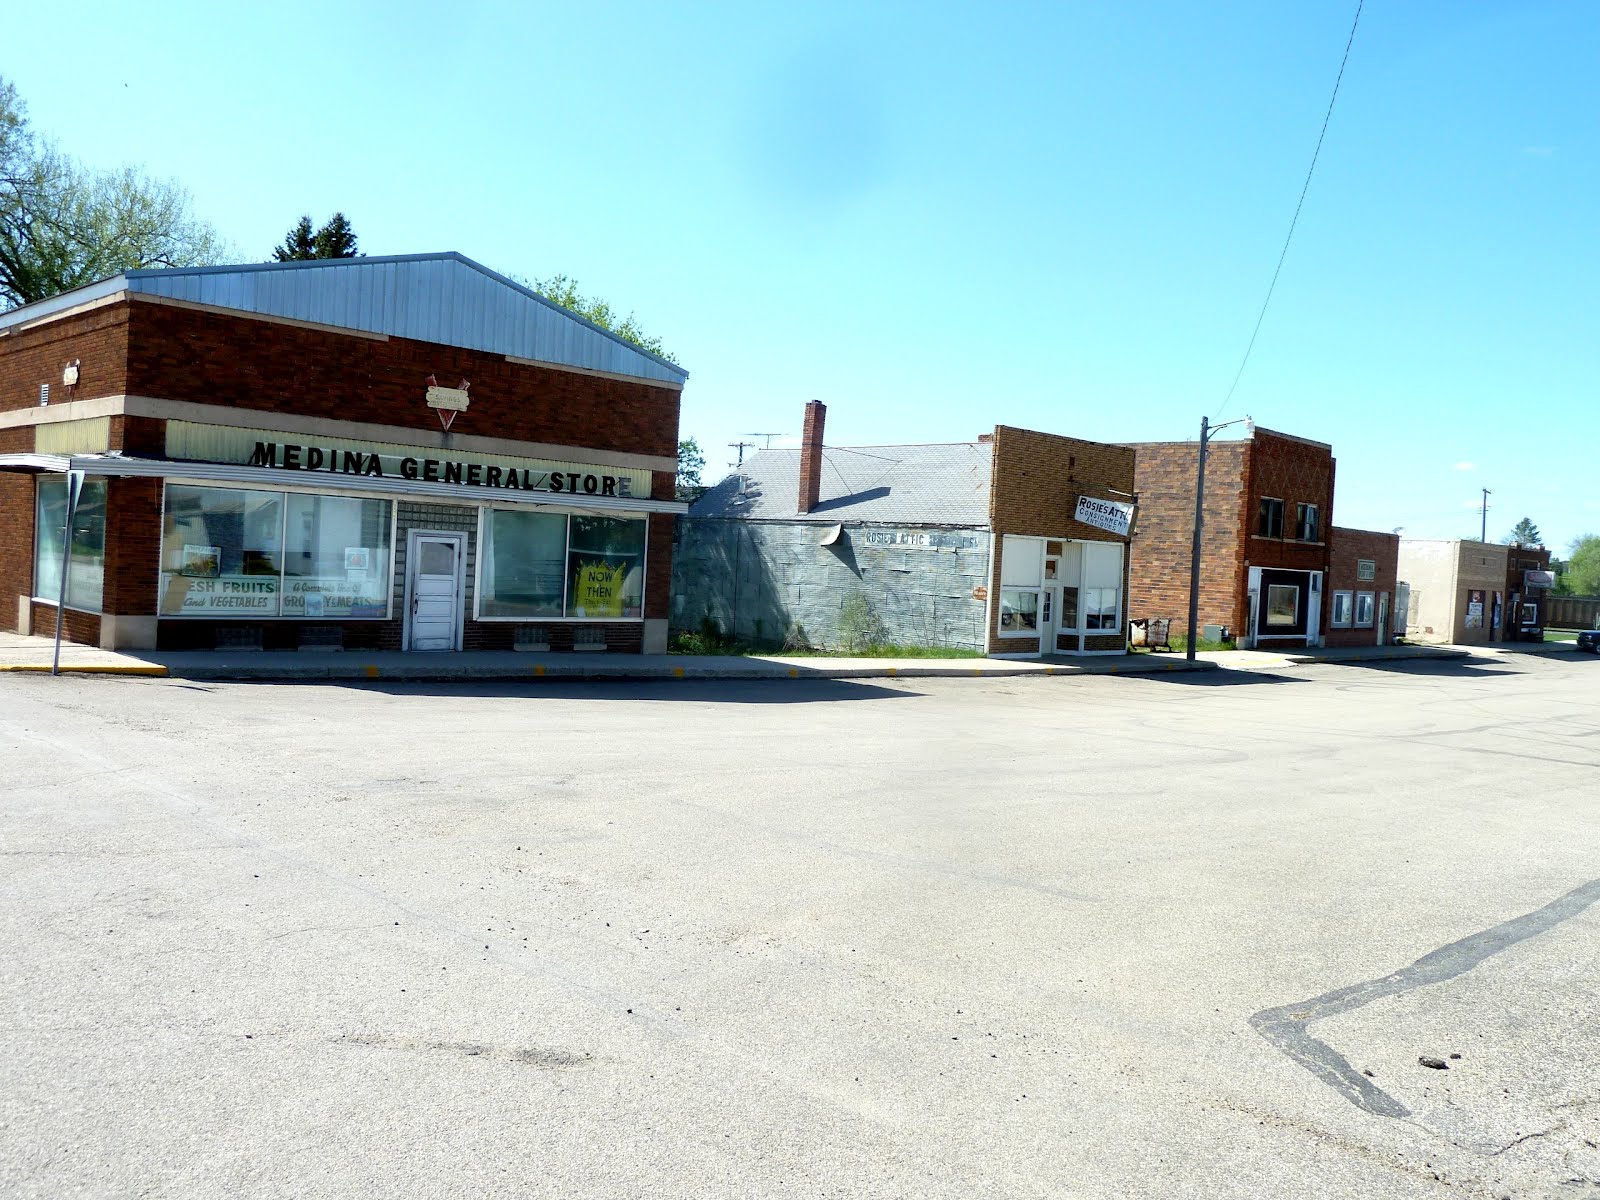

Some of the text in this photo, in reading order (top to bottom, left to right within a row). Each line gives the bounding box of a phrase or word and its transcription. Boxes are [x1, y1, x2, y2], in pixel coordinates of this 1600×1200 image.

[254, 442, 632, 498] MEDINA GENERAL STORE
[1080, 508, 1128, 529] CONSIGNMENT
[1086, 516, 1116, 531] ANTIQUES
[588, 572, 613, 582] NOW
[190, 582, 274, 594] ESH FRUITS
[586, 586, 612, 598] THEN
[210, 596, 268, 608] VEGETABLES
